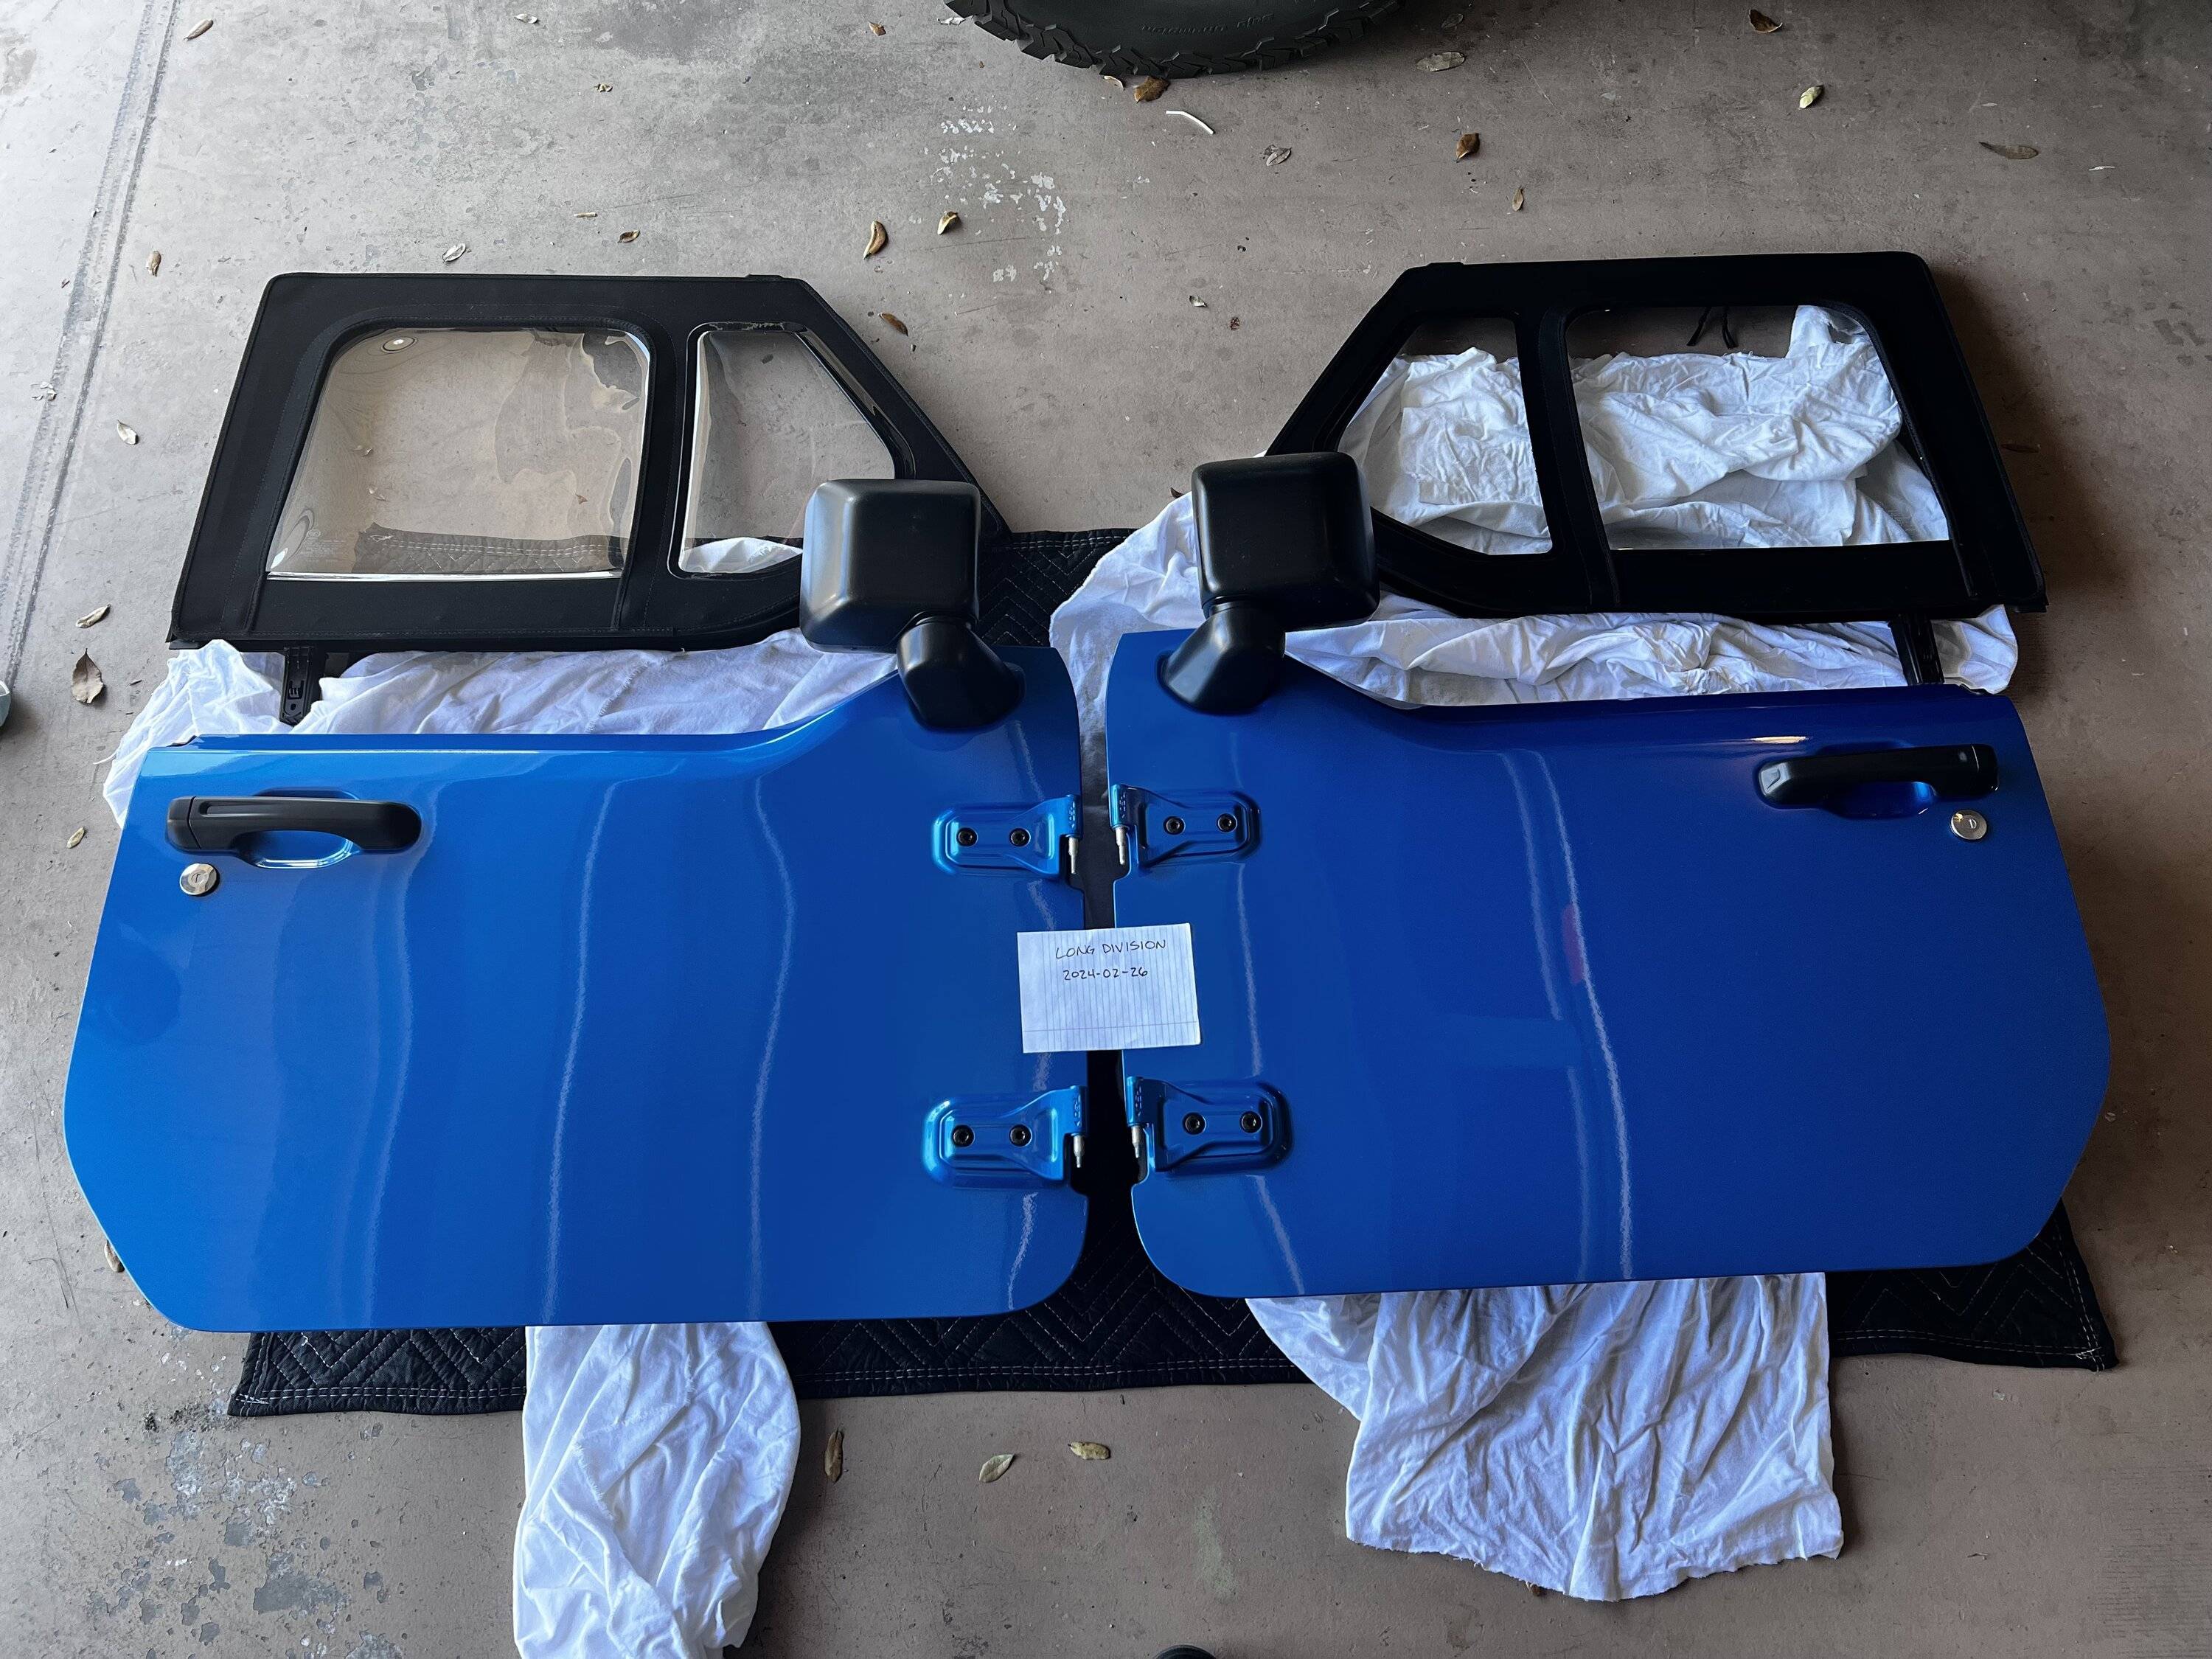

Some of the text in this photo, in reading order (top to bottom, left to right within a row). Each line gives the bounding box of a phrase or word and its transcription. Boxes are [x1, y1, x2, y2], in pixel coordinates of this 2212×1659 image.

[1055, 939, 1166, 959] LONG DIVISION
[1062, 967, 1148, 981] 2024-02-26
